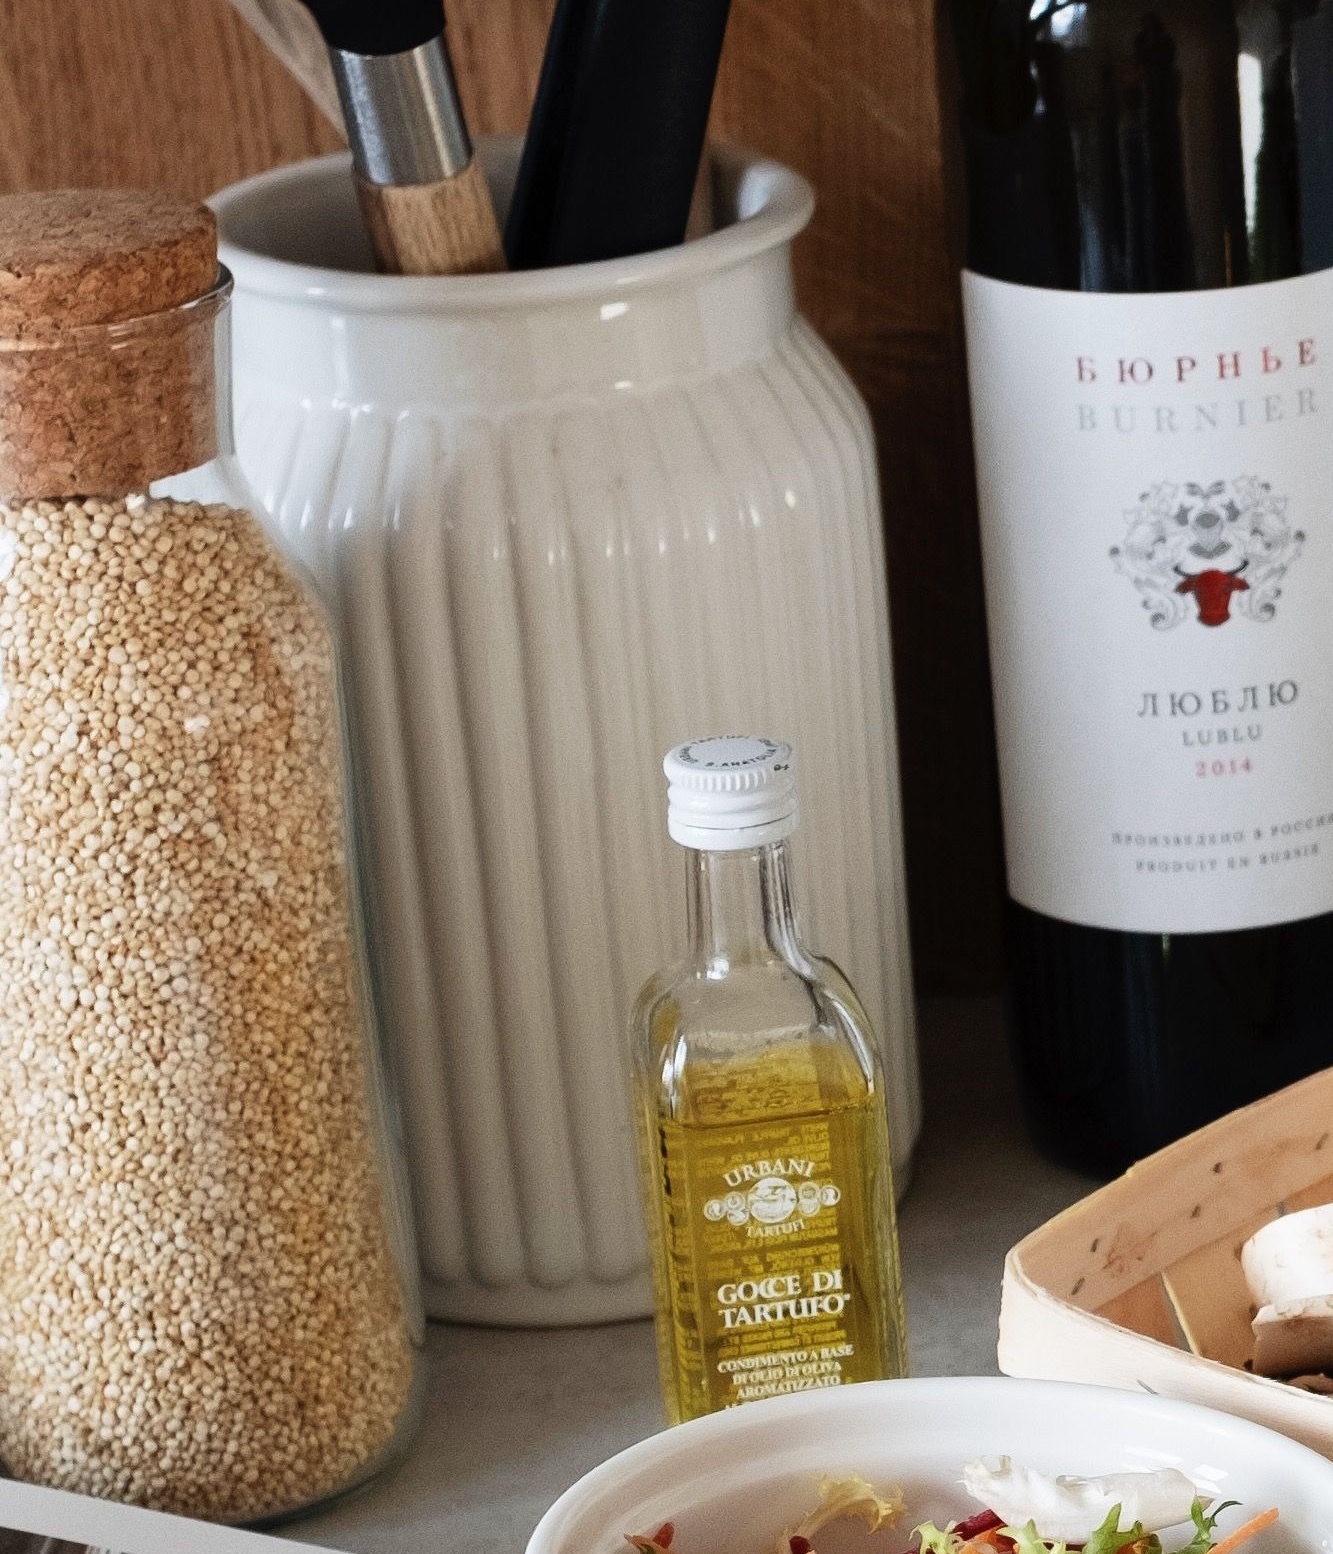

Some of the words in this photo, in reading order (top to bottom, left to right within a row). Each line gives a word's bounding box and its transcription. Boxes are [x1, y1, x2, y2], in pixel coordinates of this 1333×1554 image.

[1075, 336, 1317, 384] БЮРНЬЕ
[1078, 387, 1318, 433] BURNIER
[1137, 679, 1299, 718] ЛЮБЛЮ
[1182, 725, 1262, 747] LUBLU
[1196, 756, 1252, 779] 2014
[723, 1157, 816, 1188] URBANI
[746, 1218, 806, 1238] TARTUFI
[717, 1274, 802, 1305] GOCCE
[811, 1268, 844, 1293] DI
[717, 1350, 808, 1374] CONDIMENTO
[808, 1350, 819, 1363] A
[820, 1343, 855, 1360] BASE
